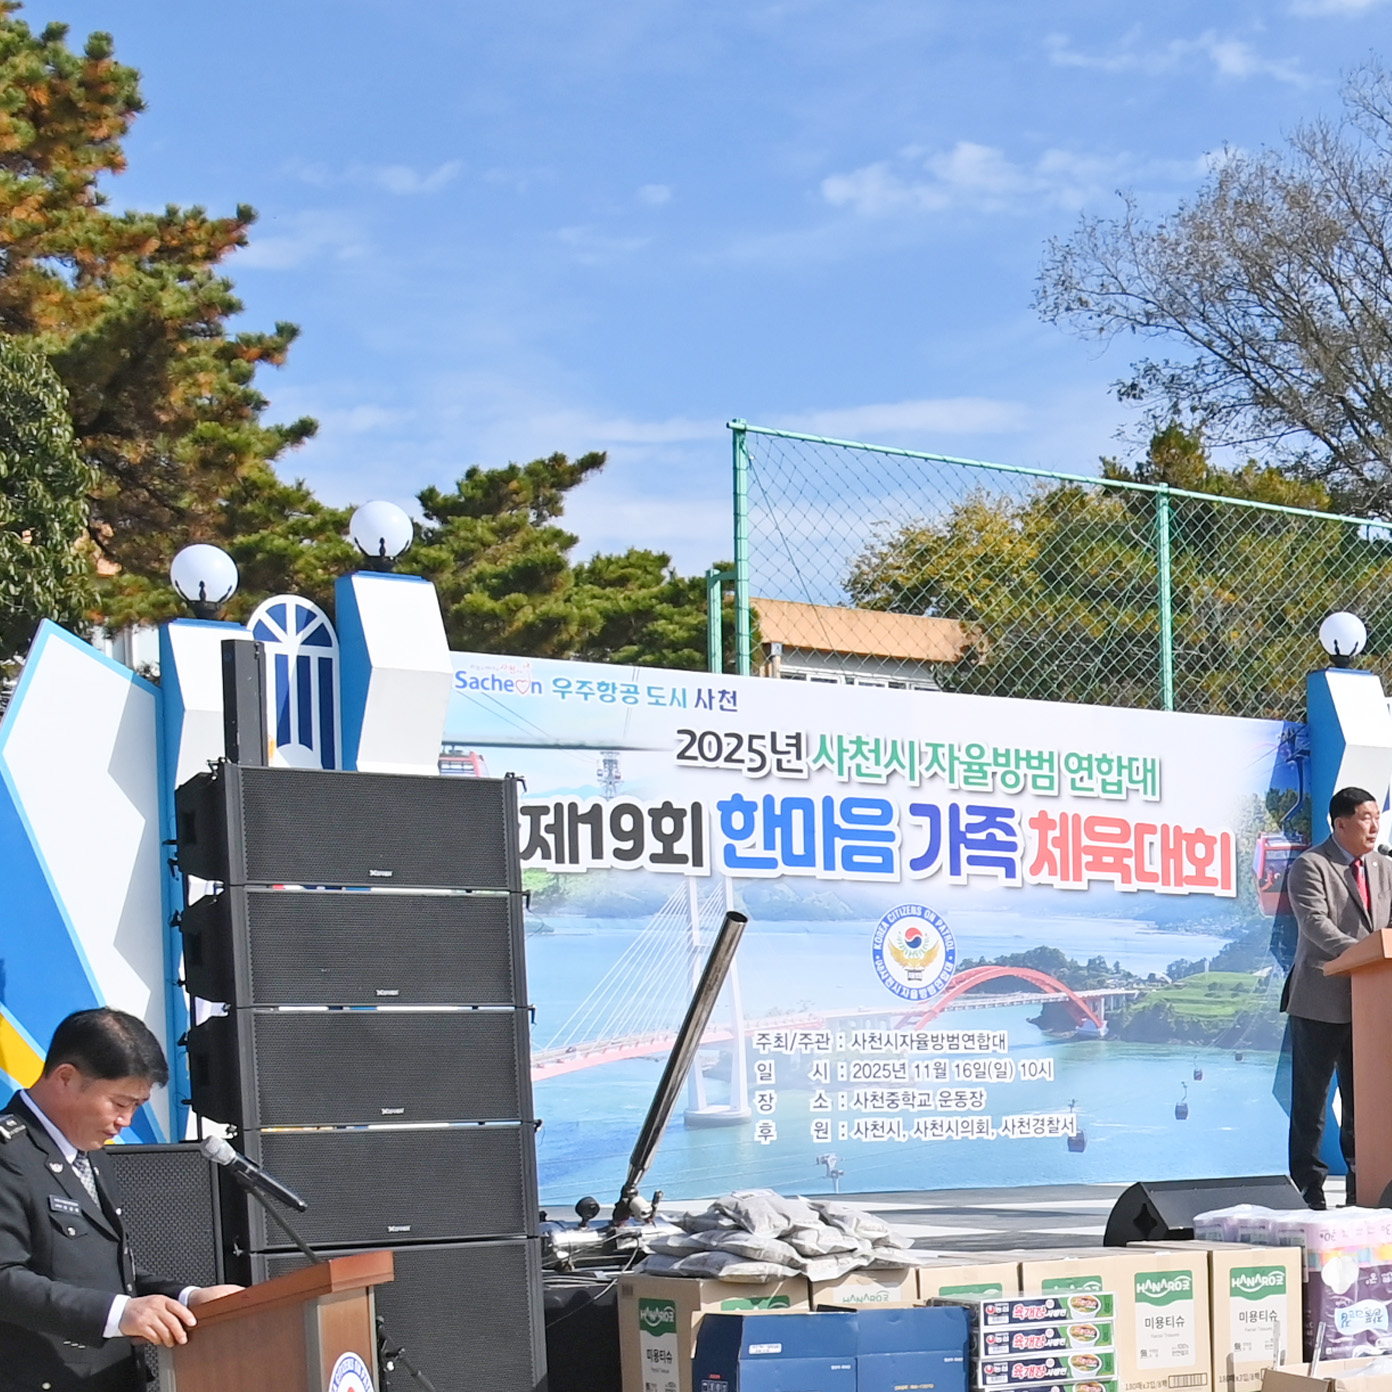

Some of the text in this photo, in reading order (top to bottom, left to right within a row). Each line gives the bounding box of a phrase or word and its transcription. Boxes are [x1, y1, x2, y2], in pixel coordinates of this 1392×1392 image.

[552, 677, 738, 712] 우주항공 도시 사천
[676, 729, 1158, 797] 2025년 사천시 자율방범 연합대
[520, 792, 1233, 891] 제19회 한마음 가족 체육대회
[873, 905, 955, 952] KOREA CITIZENS ON PATROL
[755, 1032, 831, 1052] 주최/주관
[852, 1031, 1006, 1051] 사천시자율방범연합대
[757, 1062, 774, 1081] 일
[812, 1061, 830, 1081] 시
[853, 1061, 907, 1080] 2025년
[913, 1061, 949, 1080] 11월
[954, 1060, 1014, 1080] 16일(일)
[1020, 1059, 1054, 1080] 10시
[757, 1093, 774, 1111] 장
[813, 1092, 830, 1110] 소
[853, 1090, 933, 1110] 사천중학교
[938, 1088, 985, 1109] 운동장
[757, 1123, 775, 1142] 후
[813, 1120, 831, 1140] 원
[854, 1120, 908, 1141] 사천시,
[913, 1118, 996, 1141] 사천시의회,
[1002, 1116, 1077, 1138] 사천경찰서
[1012, 1303, 1047, 1321] 육개장
[1145, 1315, 1185, 1329] 미용티슈
[1239, 1310, 1278, 1323] 미용티슈
[1012, 1333, 1047, 1349] 육개장
[1012, 1362, 1047, 1379] 육개장
